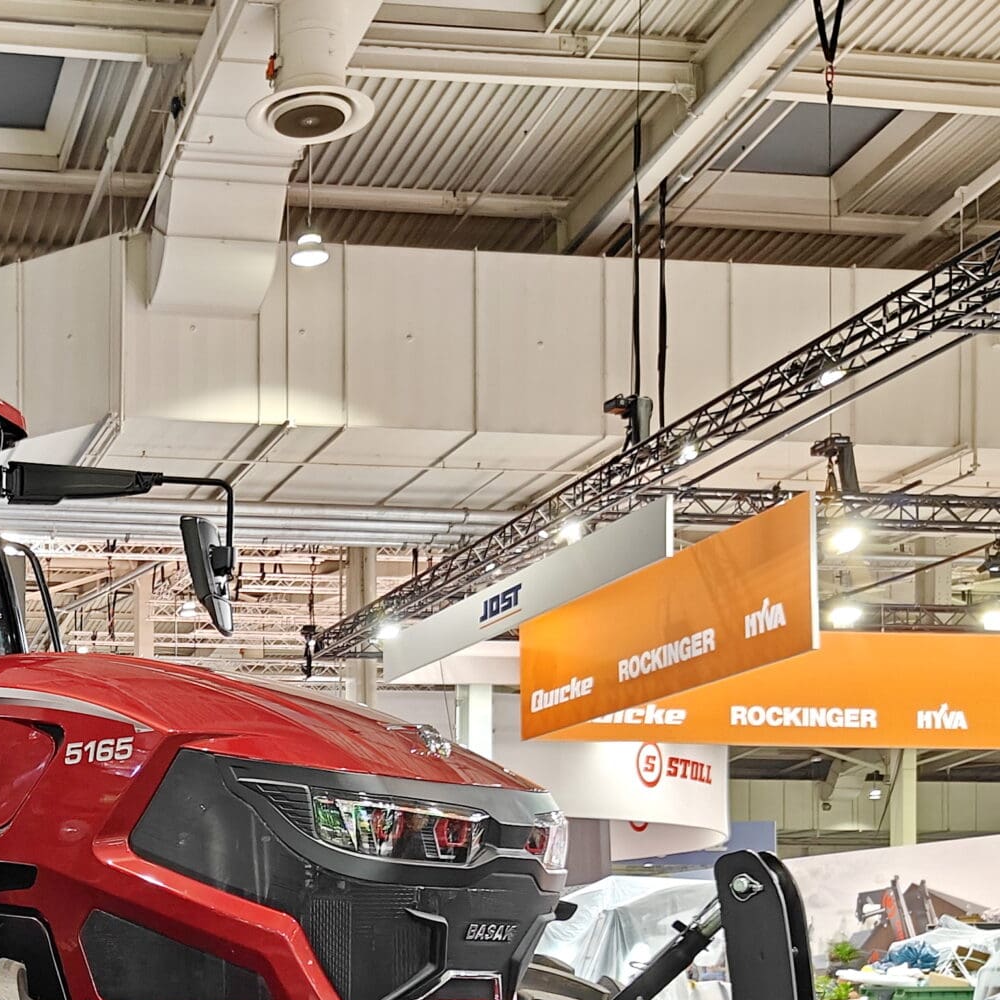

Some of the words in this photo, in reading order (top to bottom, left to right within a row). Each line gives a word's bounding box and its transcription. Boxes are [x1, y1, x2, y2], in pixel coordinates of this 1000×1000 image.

[480, 583, 522, 622] JOST
[531, 675, 594, 713] Quicke
[618, 627, 716, 683] ROCKINGER
[744, 597, 787, 639] HYVA
[590, 703, 687, 725] icke
[730, 705, 877, 728] ROCKINGER
[917, 702, 968, 730] HYVA
[64, 736, 134, 765] 5165
[666, 756, 712, 785] STOLL
[466, 923, 518, 941] BASAK
